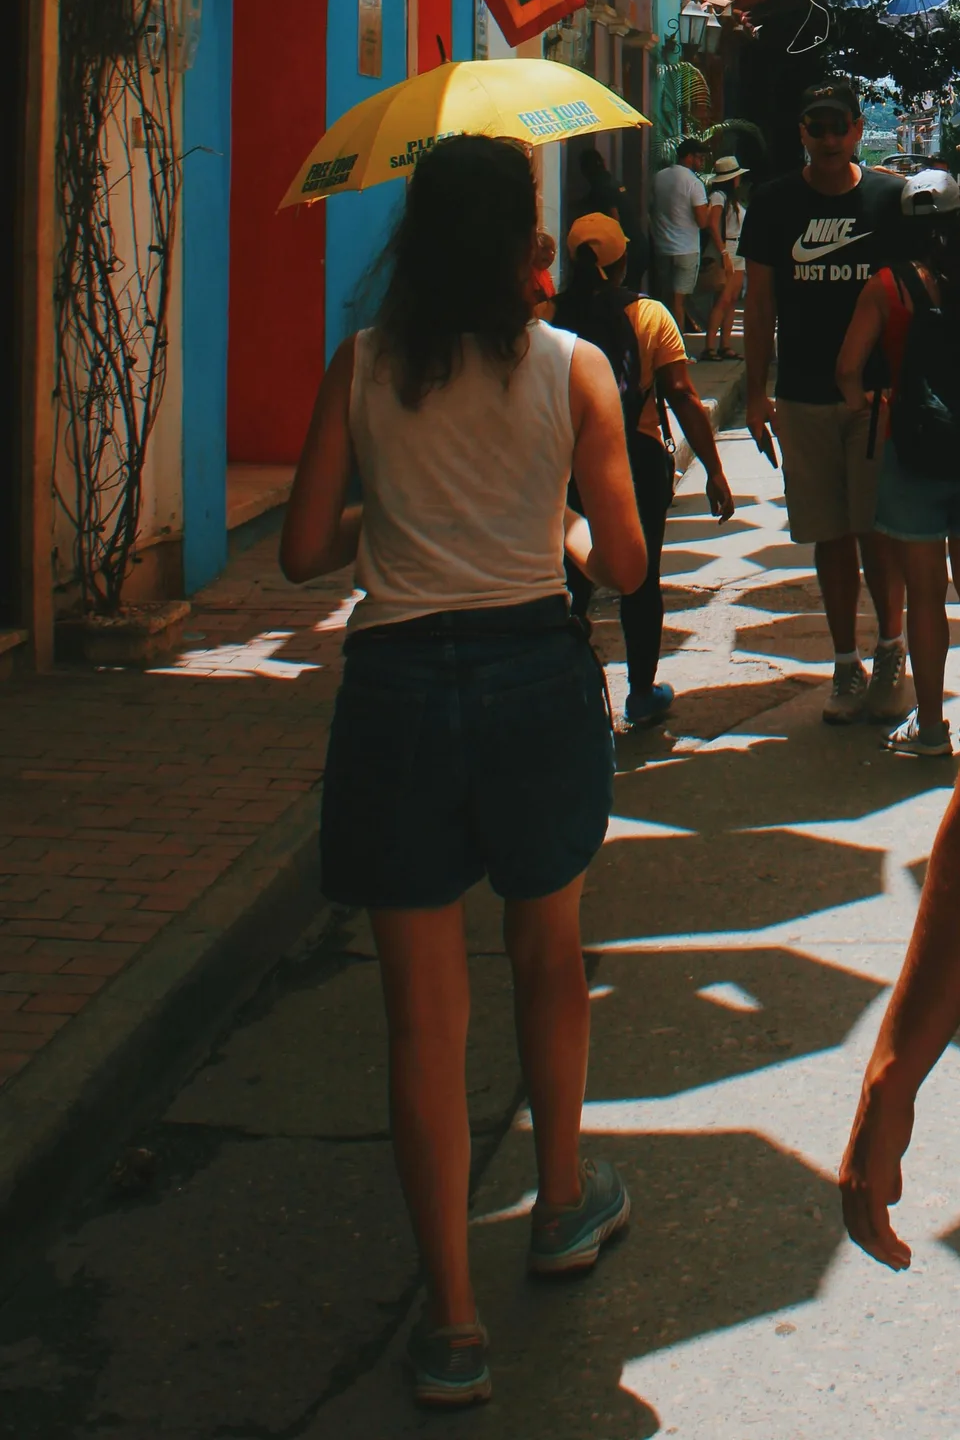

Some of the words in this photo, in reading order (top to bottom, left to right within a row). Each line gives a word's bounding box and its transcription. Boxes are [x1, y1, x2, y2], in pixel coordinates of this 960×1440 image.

[518, 109, 556, 127] FREE
[551, 100, 593, 121] TOUR
[529, 114, 602, 136] CARTAGENA
[305, 160, 333, 182] FREE
[329, 153, 359, 176] TOUR
[803, 218, 856, 242] NIKE
[794, 264, 826, 281] JUST
[830, 264, 852, 281] DO
[856, 263, 872, 280] IT.
